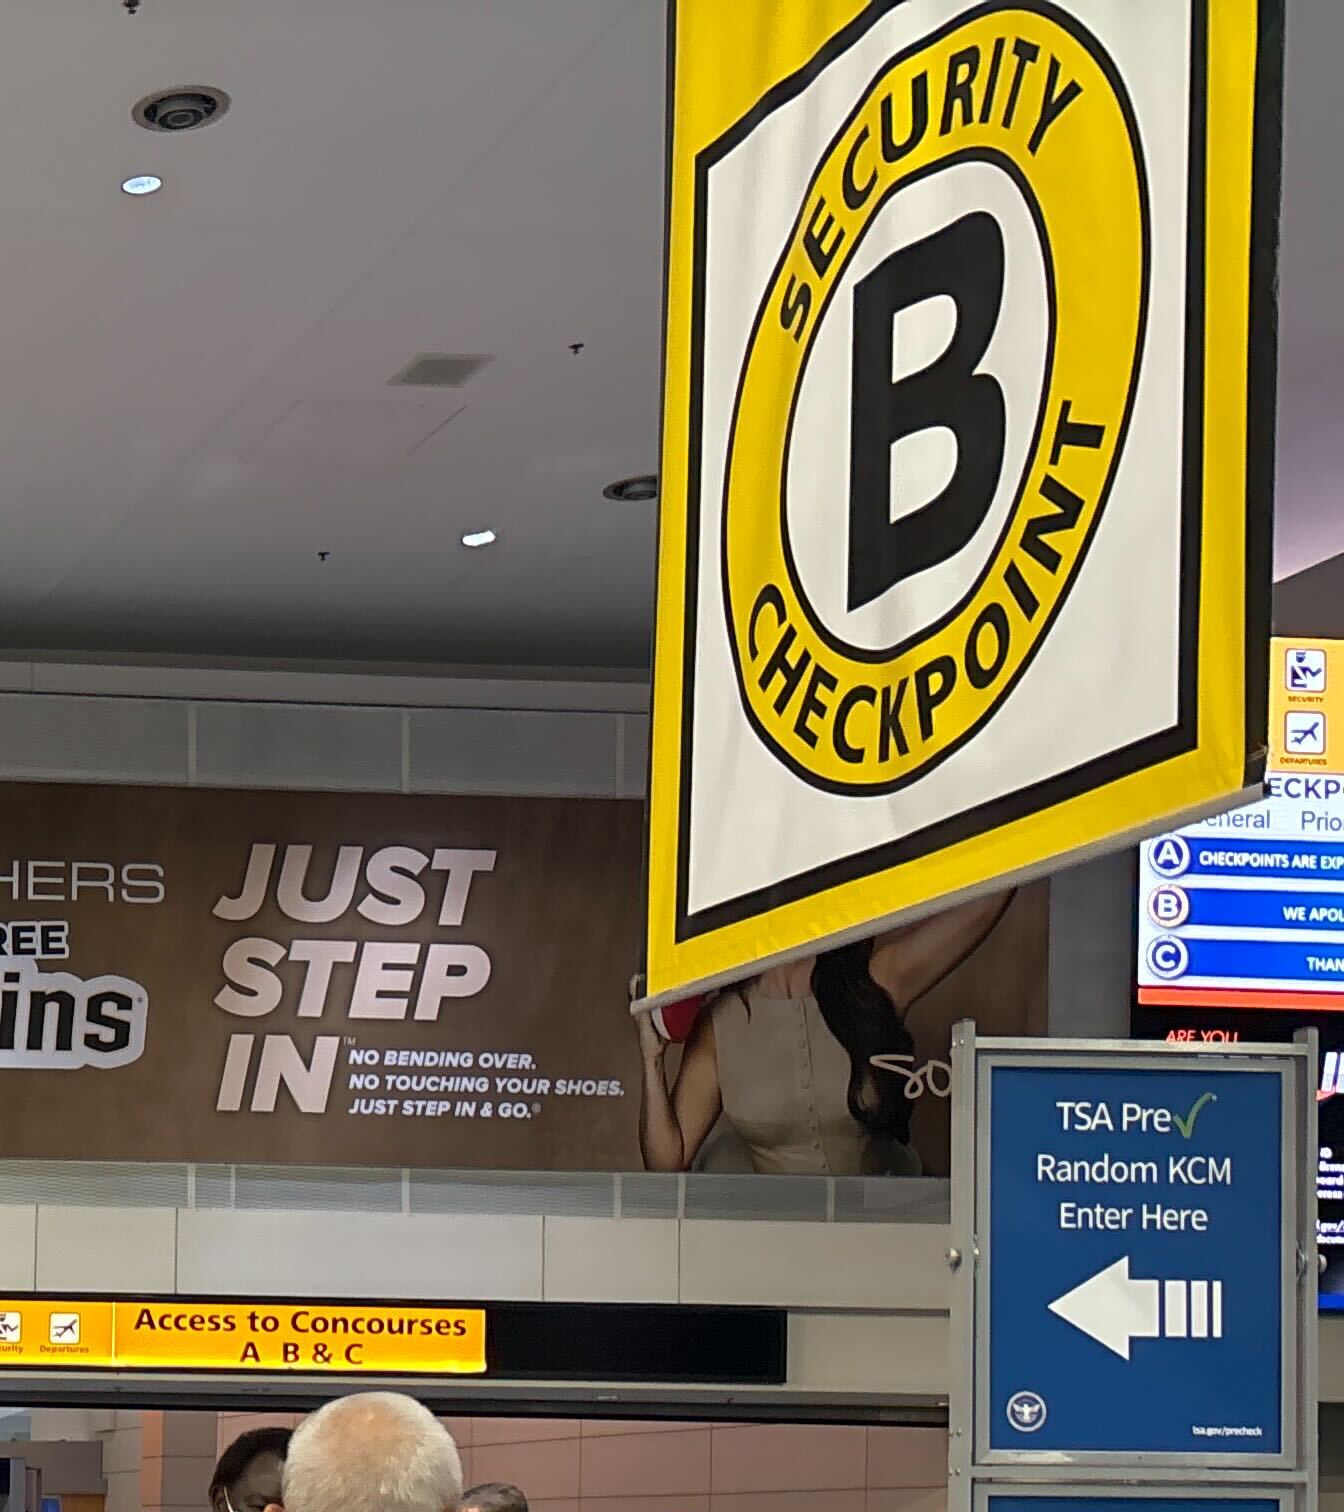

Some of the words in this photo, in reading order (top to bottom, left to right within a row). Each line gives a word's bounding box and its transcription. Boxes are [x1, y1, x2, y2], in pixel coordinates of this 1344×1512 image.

[779, 36, 1085, 344] SECURITY
[847, 209, 1005, 613] B
[745, 398, 1107, 765] CHECKPOINT
[1302, 811, 1344, 832] Prio
[1158, 842, 1180, 865] A
[1199, 850, 1289, 869] CHECKPOINTS
[1292, 853, 1318, 869] ARE
[1320, 854, 1344, 870] EXP
[212, 843, 498, 927] JUST
[1158, 897, 1178, 918] B
[1283, 906, 1306, 921] WE
[1309, 907, 1344, 923] APOL
[1157, 946, 1177, 967] C
[1307, 956, 1344, 972] THAN
[214, 936, 492, 1021] STEP
[348, 1050, 379, 1064] NO
[384, 1050, 473, 1068] BENDING
[478, 1053, 536, 1070] OVER.
[216, 1033, 341, 1114] IN
[348, 1074, 379, 1090] NO
[385, 1075, 489, 1092] TOUCHING
[495, 1077, 551, 1094] YOUR
[554, 1080, 624, 1096] SHOES.
[348, 1099, 398, 1114] JUST
[402, 1100, 450, 1116] STEP
[454, 1102, 476, 1117] IN
[480, 1102, 492, 1118] &
[1056, 1102, 1113, 1131] TSA
[1122, 1103, 1172, 1132] Pre
[1037, 1153, 1158, 1184] Random
[1169, 1157, 1232, 1185] KCM
[1060, 1202, 1133, 1231] Enter
[1142, 1204, 1208, 1232] Here
[134, 1308, 236, 1331] Access
[248, 1311, 280, 1332] to
[290, 1311, 467, 1336] Concourses
[40, 1345, 89, 1354] Departures
[240, 1342, 260, 1362] A
[282, 1342, 300, 1363] B
[312, 1343, 333, 1364] &
[344, 1343, 363, 1365] C
